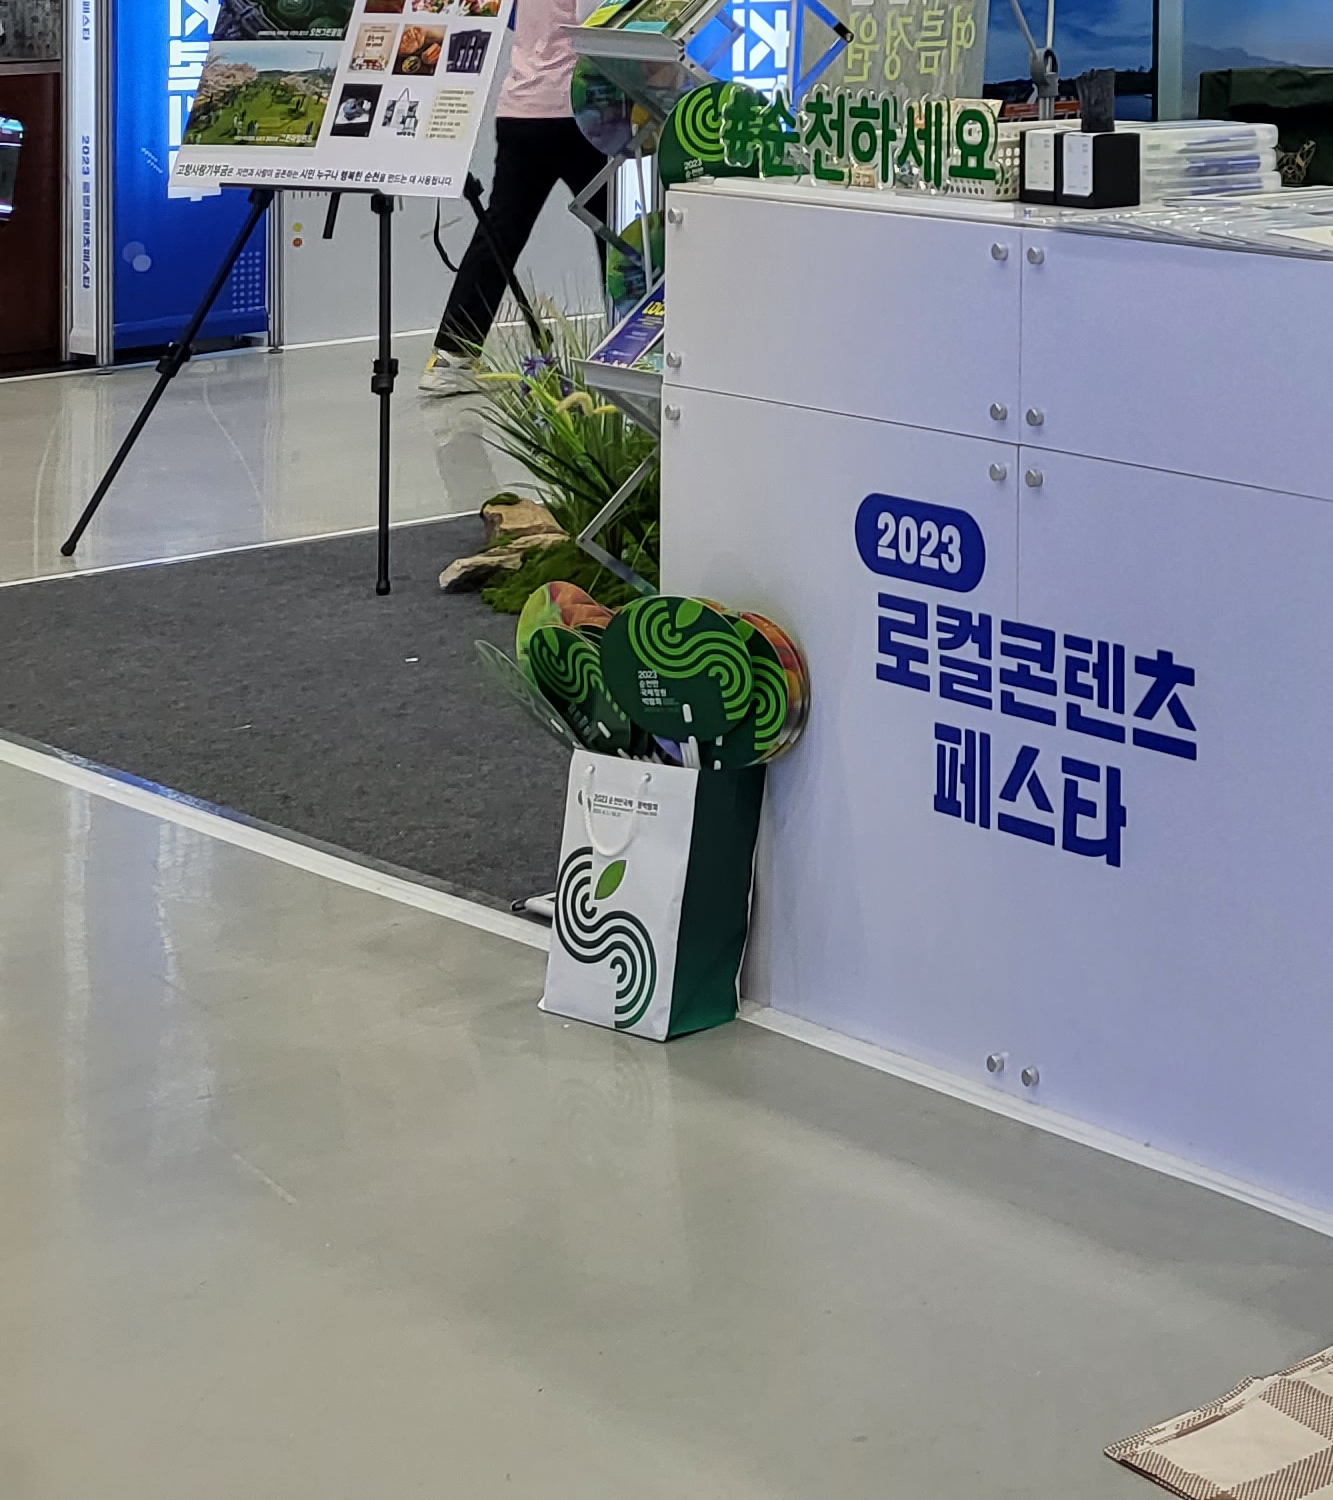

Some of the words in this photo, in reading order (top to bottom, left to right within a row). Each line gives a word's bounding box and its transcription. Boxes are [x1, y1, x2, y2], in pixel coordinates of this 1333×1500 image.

[81, 135, 91, 175] 2023
[876, 511, 962, 574] 2023
[876, 591, 1197, 761] 로컬콘텐츠
[933, 722, 1127, 868] 페스타
